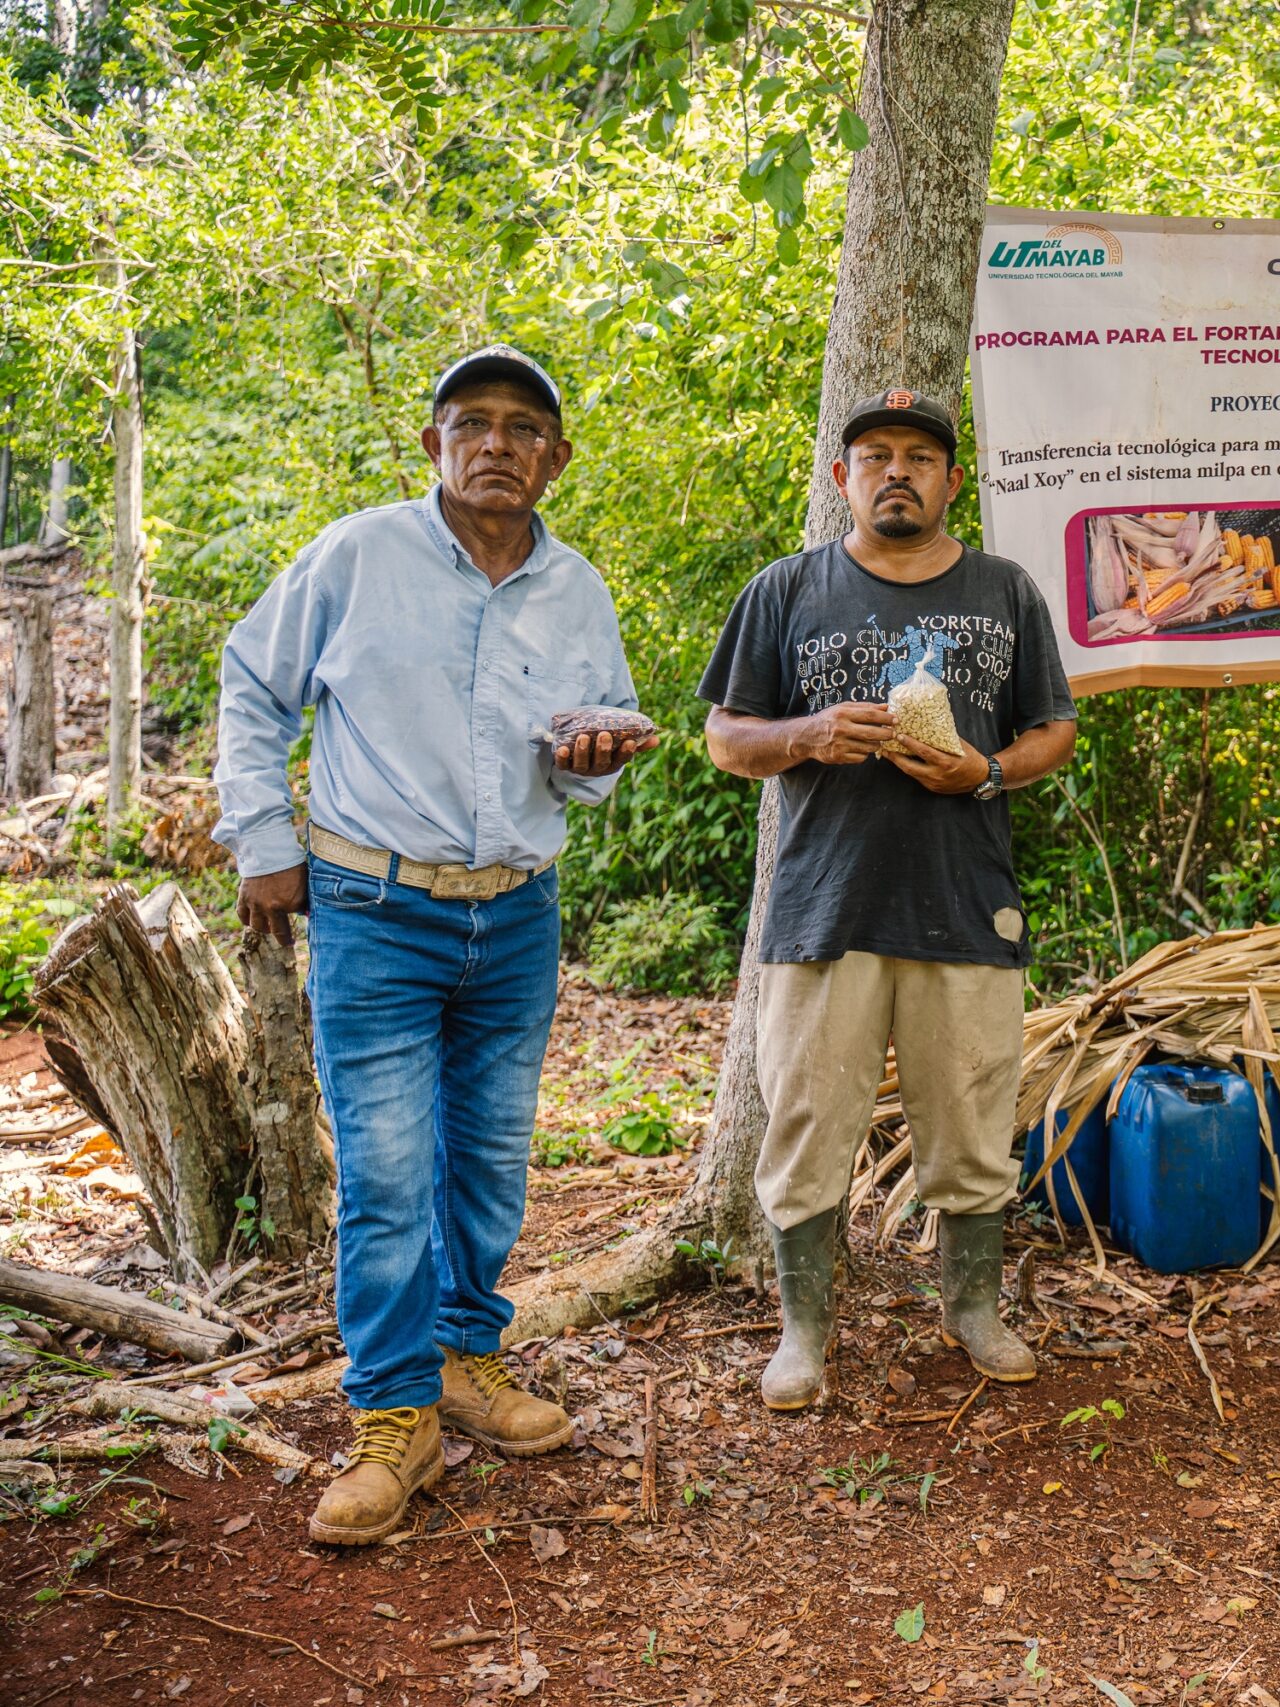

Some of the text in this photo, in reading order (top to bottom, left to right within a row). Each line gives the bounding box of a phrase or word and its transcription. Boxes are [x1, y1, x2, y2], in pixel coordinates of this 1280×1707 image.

[1042, 240, 1062, 249] DEL
[1024, 248, 1106, 268] MAYAB
[1036, 271, 1084, 279] TECNOLÓGICA
[975, 330, 1100, 351] PROGRAMA
[1106, 327, 1166, 344] PARA
[1173, 326, 1198, 342] EL
[999, 441, 1112, 467] Transferencia
[1117, 437, 1216, 457] tecnológica
[1221, 438, 1259, 456] para
[1080, 471, 1101, 484] en
[1106, 466, 1122, 481] el
[1126, 465, 1192, 481] sistema
[1197, 461, 1245, 481] milpa
[1250, 463, 1271, 476] en
[917, 615, 1015, 646] YORKTEAM
